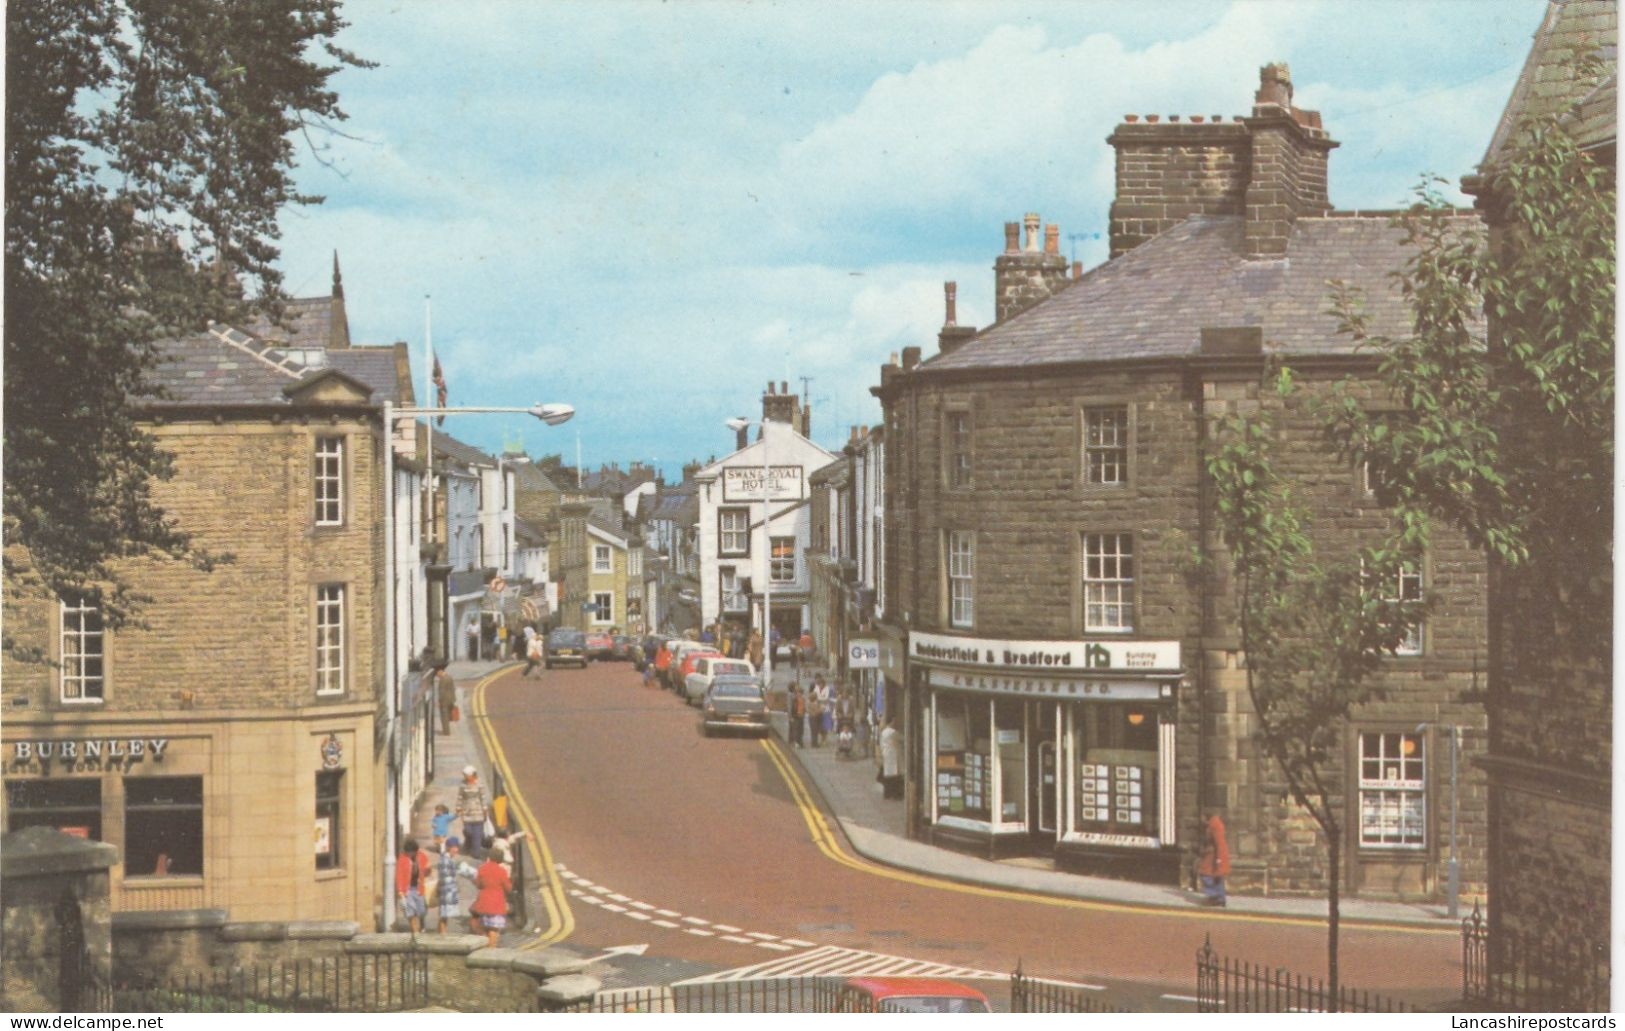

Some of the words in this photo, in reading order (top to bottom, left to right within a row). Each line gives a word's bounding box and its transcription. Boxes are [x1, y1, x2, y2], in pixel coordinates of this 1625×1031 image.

[742, 479, 782, 489] HOTEL
[851, 646, 877, 659] Gas
[986, 649, 995, 663] &
[1003, 650, 1071, 666] Bradford
[16, 739, 167, 759] BURNLEY
